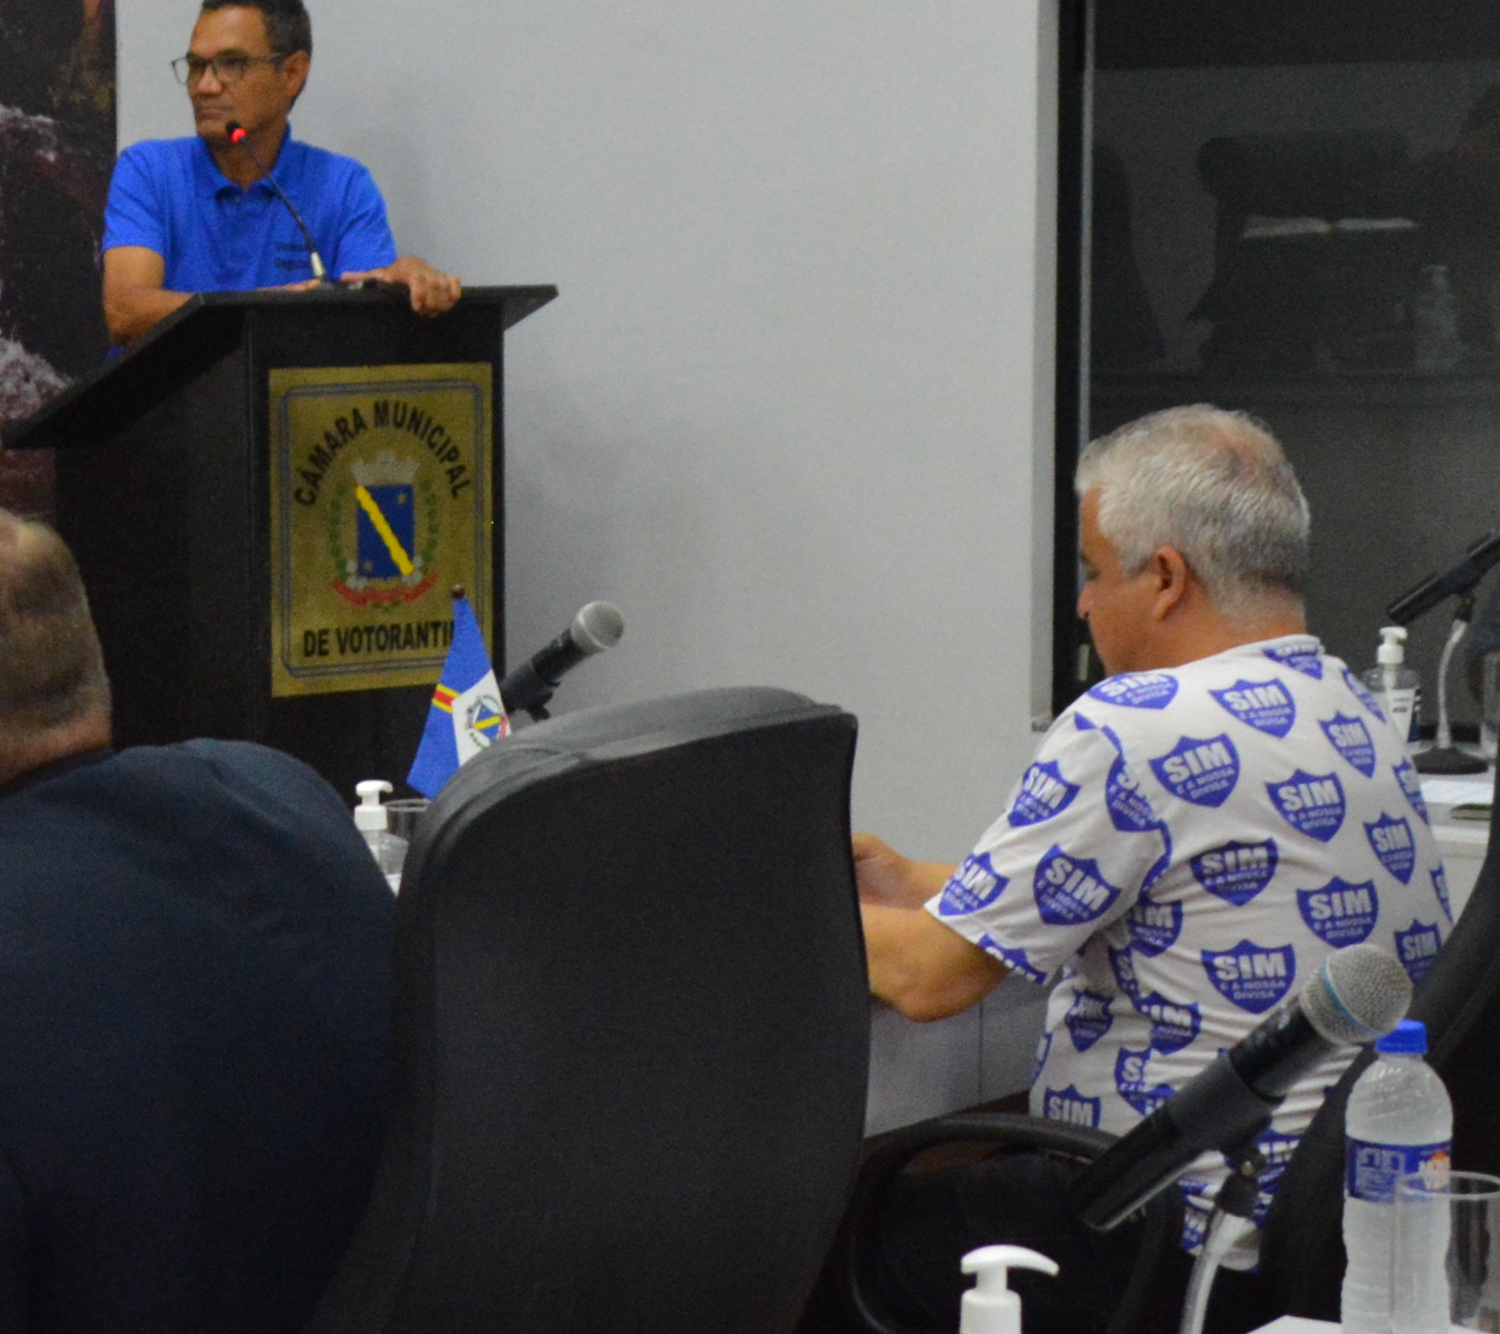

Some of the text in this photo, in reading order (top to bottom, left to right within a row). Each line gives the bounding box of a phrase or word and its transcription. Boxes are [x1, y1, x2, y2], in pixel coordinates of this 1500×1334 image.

[373, 400, 473, 500] MUNICIPAL
[303, 620, 454, 657] DE VOTORANTI
[1223, 684, 1290, 711] SIM
[1328, 721, 1369, 747] SIM
[1162, 741, 1233, 784] SIM
[1022, 765, 1069, 809] SIM
[1277, 779, 1341, 812] SIM
[1371, 825, 1411, 852] SIM
[1200, 845, 1269, 875] SIM
[1046, 857, 1109, 912] SIM
[1308, 888, 1372, 920] SIM
[1402, 930, 1438, 960] SIM
[1213, 952, 1287, 981] SIM
[1233, 989, 1276, 1000] DIVISA
[1243, 978, 1286, 990] NOSSA
[1048, 1095, 1093, 1128] SIM
